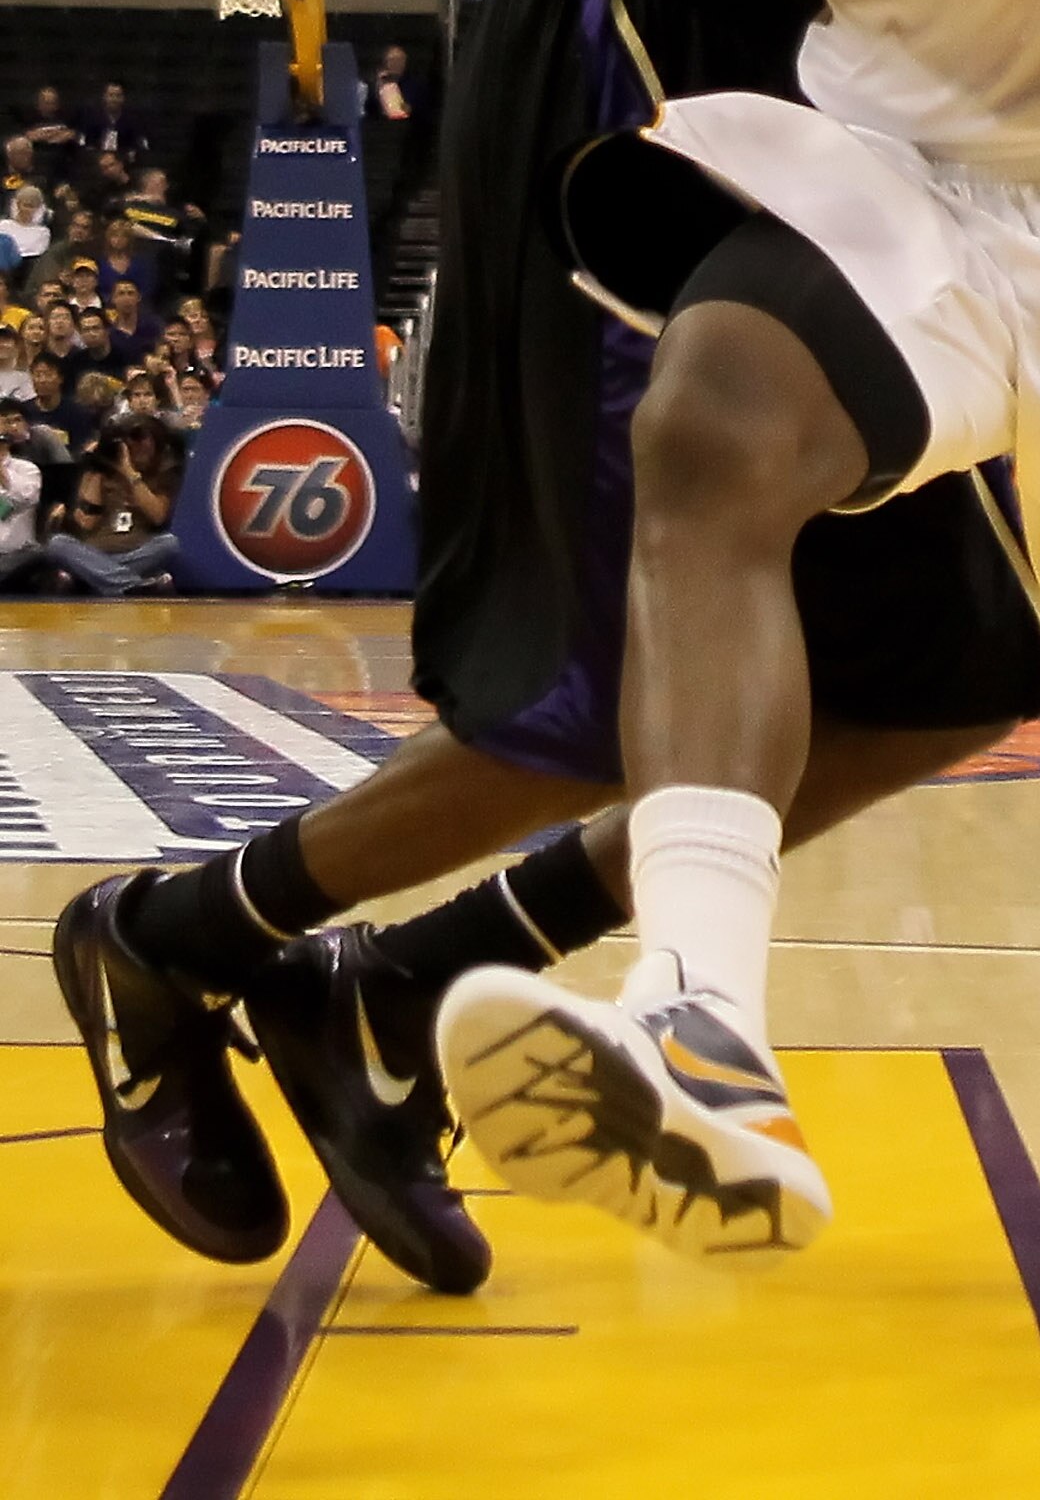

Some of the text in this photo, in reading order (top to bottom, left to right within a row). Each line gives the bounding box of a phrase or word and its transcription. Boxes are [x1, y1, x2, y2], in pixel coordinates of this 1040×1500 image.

[261, 139, 347, 153] PACIFIC LIFE
[252, 200, 353, 218] PACIFIC LIFE
[244, 269, 359, 288] PACIFIC LIFE
[235, 346, 365, 368] PACIFIC LIFE
[240, 457, 350, 542] 76
